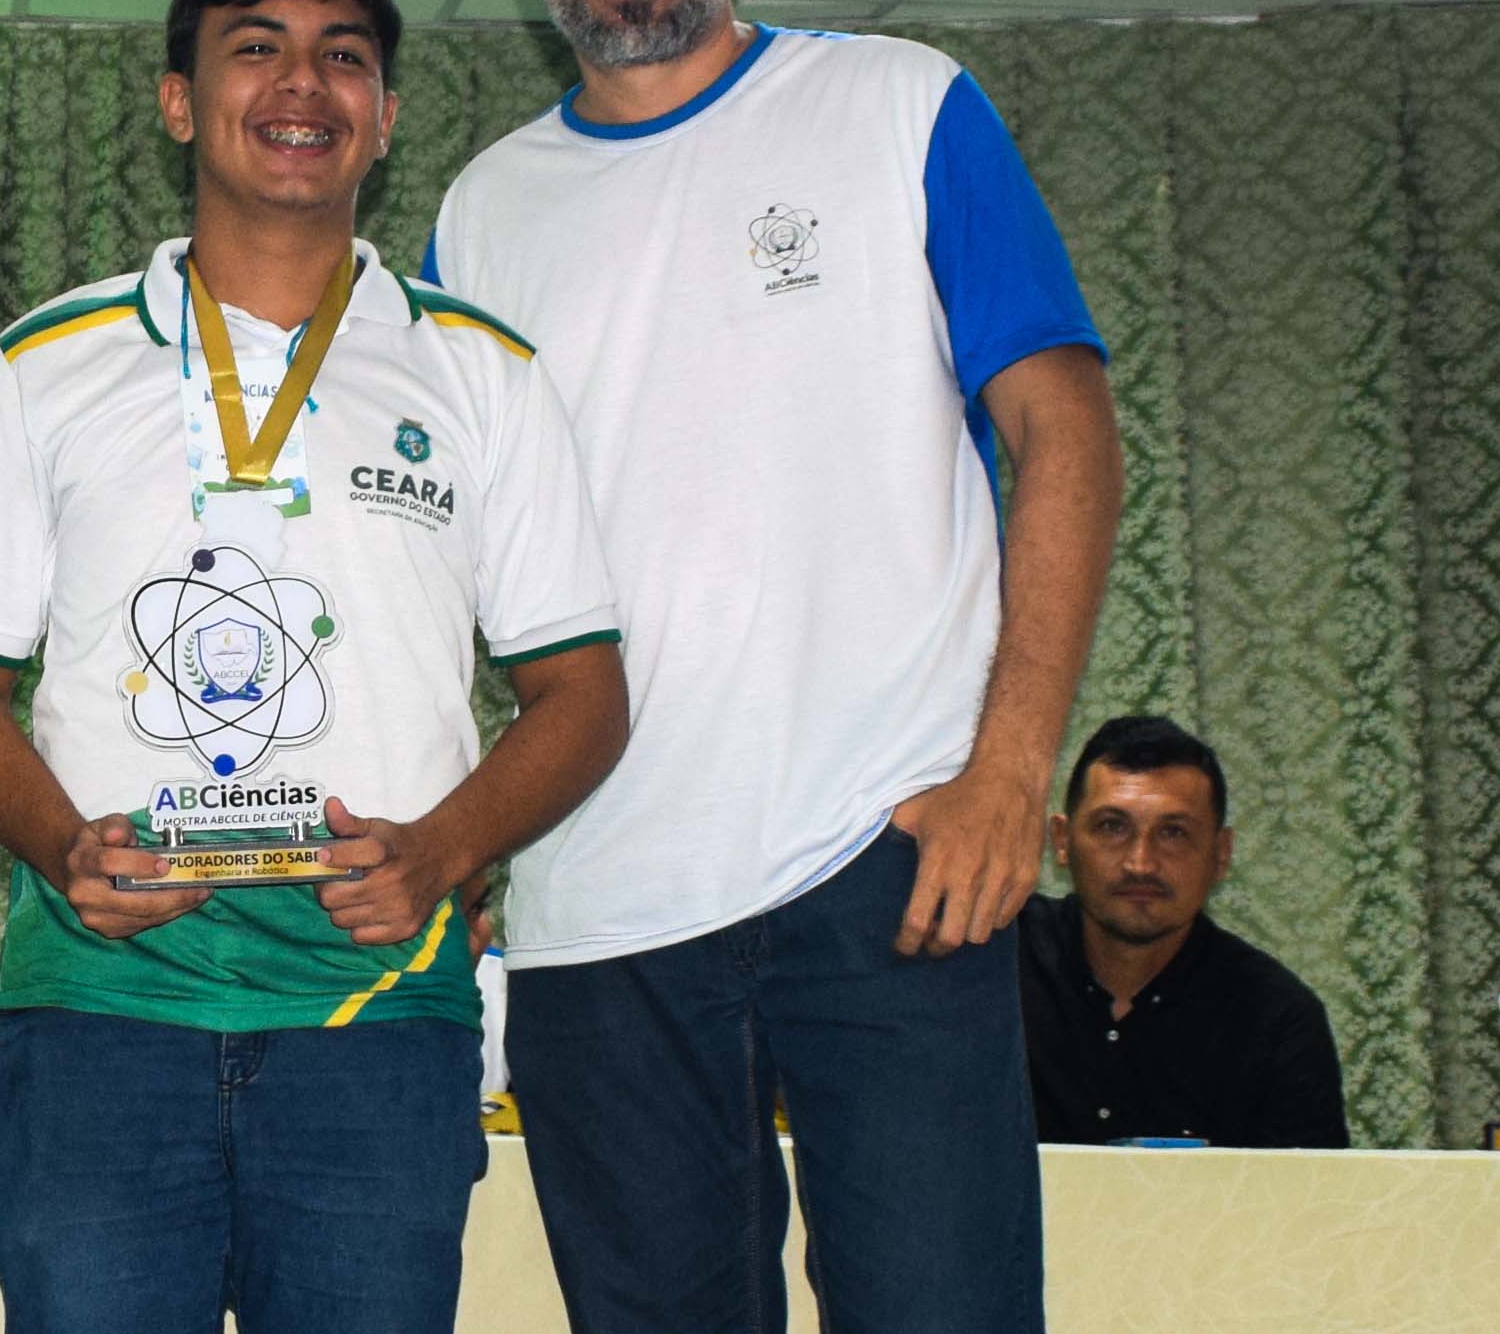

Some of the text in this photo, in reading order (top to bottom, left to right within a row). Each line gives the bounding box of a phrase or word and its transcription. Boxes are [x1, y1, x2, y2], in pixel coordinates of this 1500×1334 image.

[351, 466, 454, 514] CEARÁ
[350, 491, 451, 525] GOVERNO DO ESTADO
[155, 781, 318, 812] ABCiências
[164, 816, 208, 827] MOSTRA
[210, 813, 250, 824] ABCCEL
[253, 812, 266, 822] DE
[270, 810, 319, 821] CIÊNCIAS
[167, 853, 259, 868] PLORADORES
[263, 852, 283, 865] DO
[195, 868, 242, 878] Engenharia
